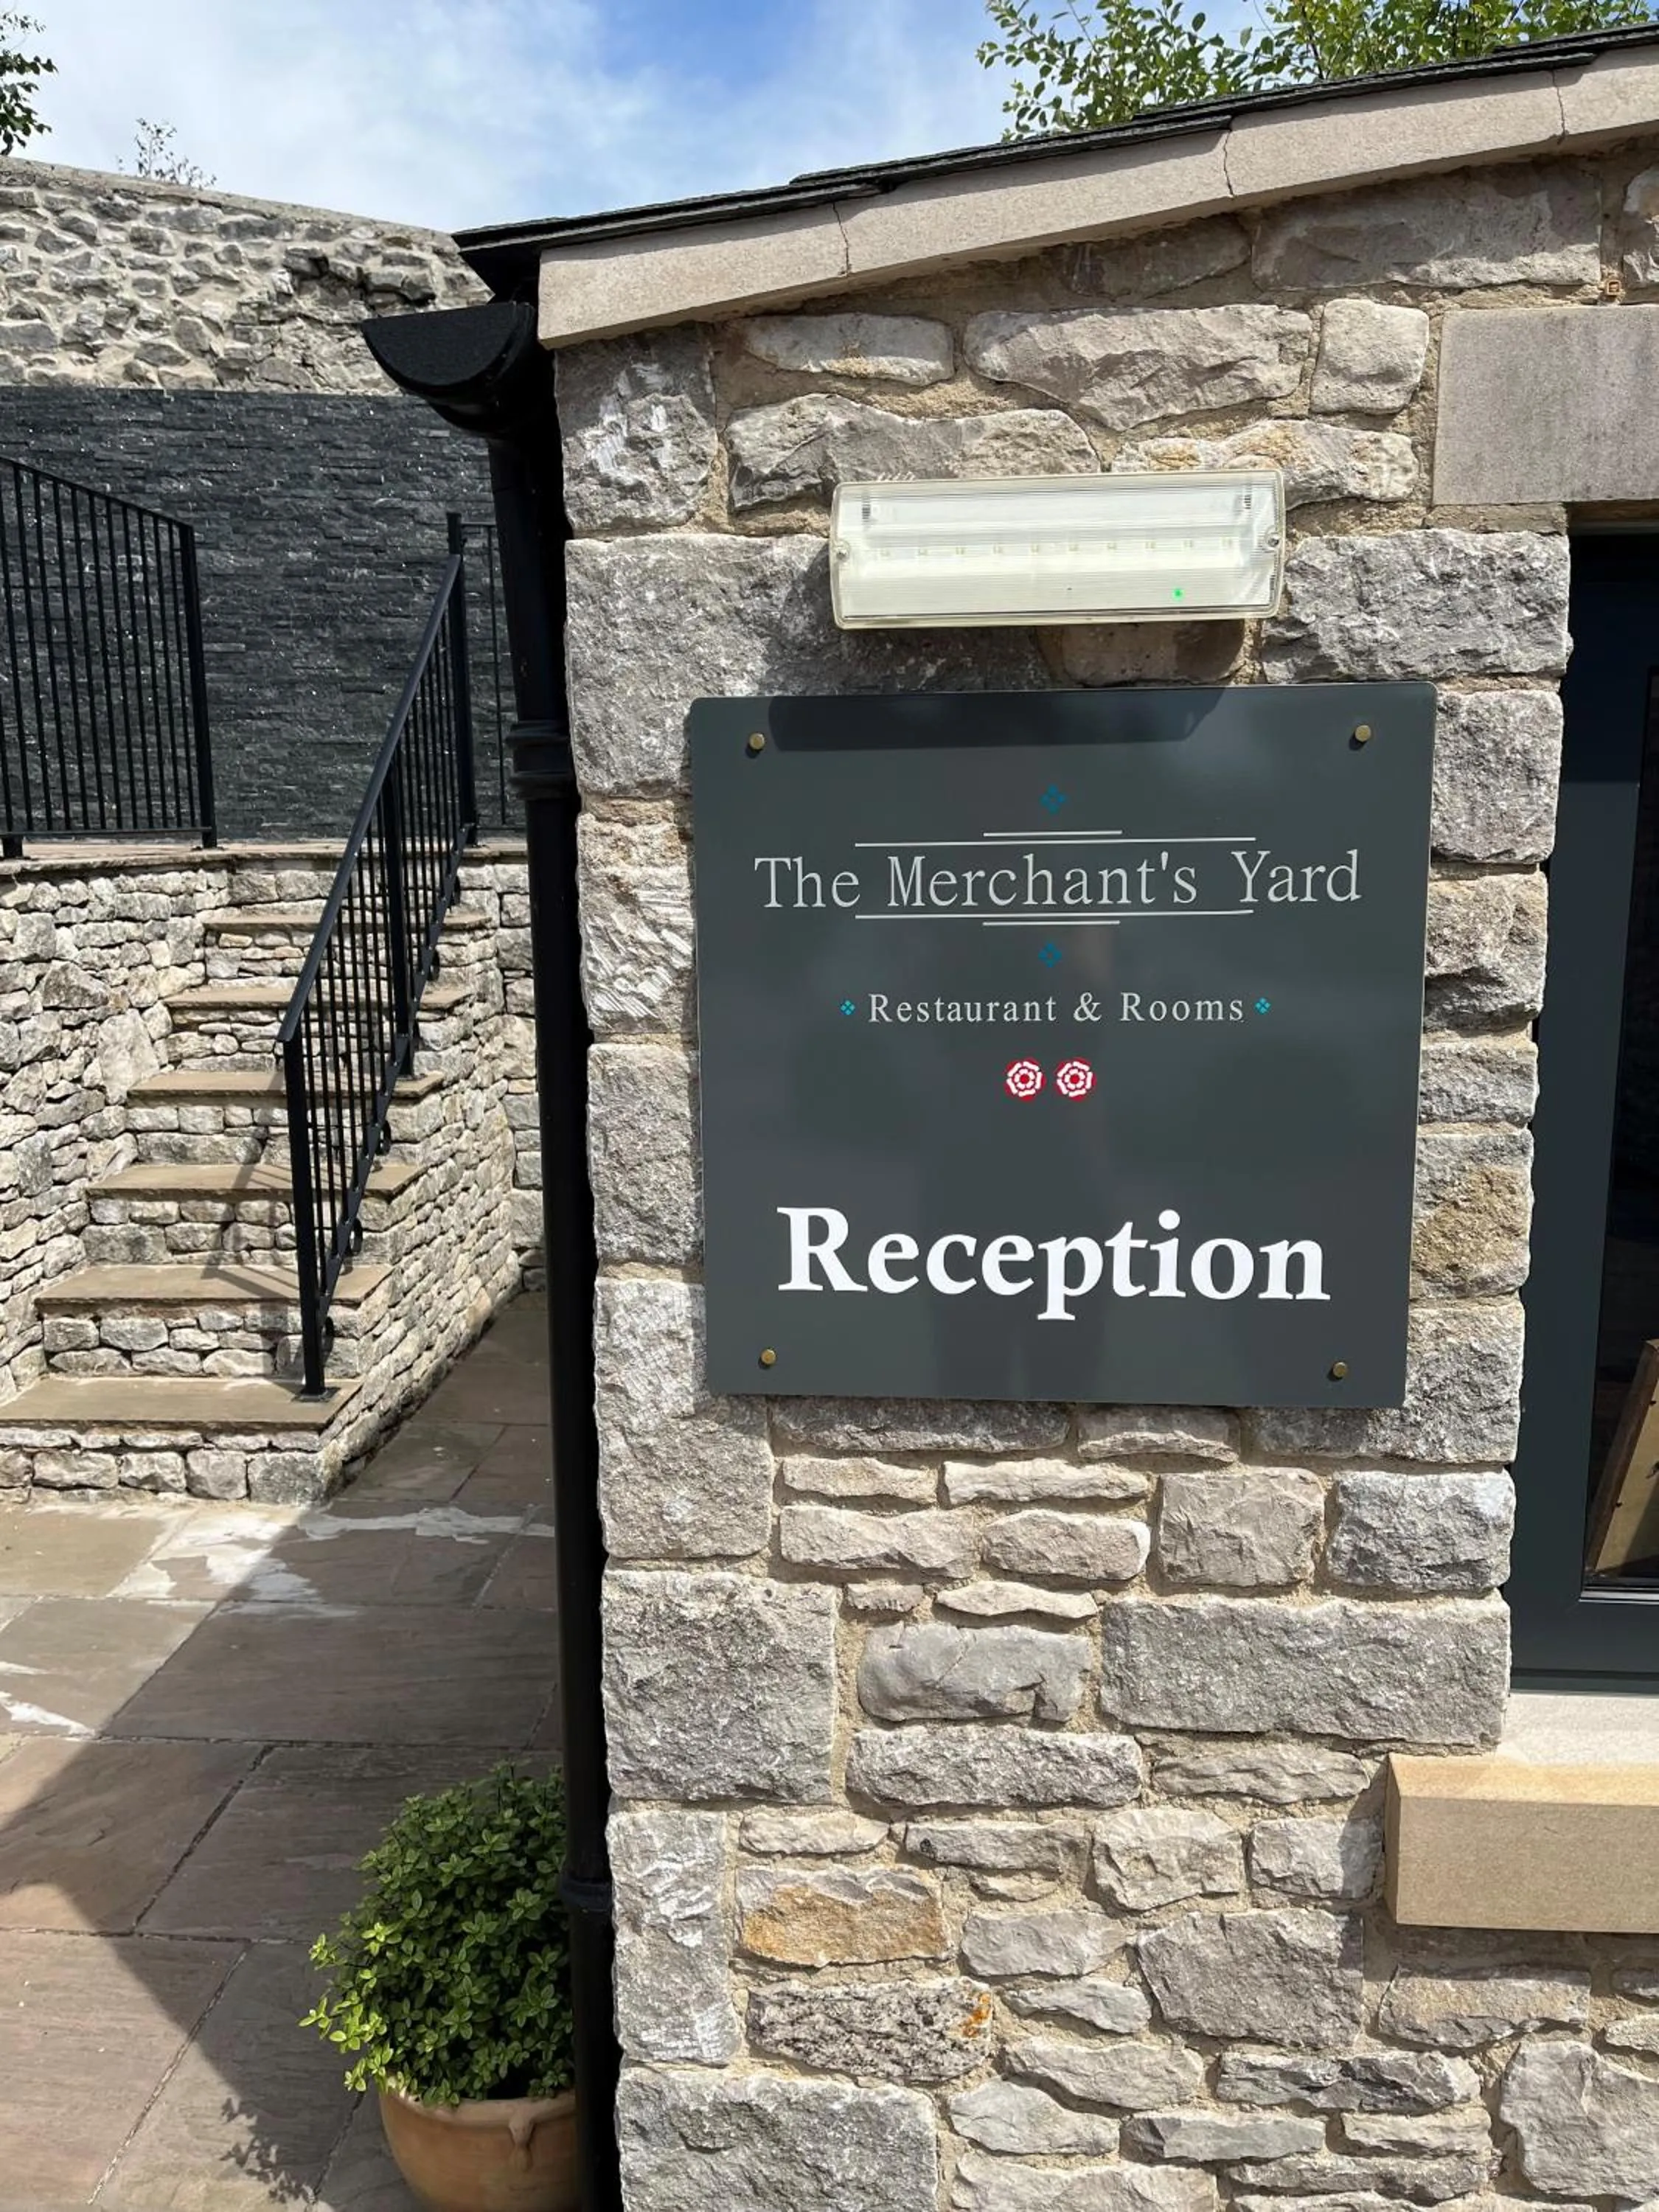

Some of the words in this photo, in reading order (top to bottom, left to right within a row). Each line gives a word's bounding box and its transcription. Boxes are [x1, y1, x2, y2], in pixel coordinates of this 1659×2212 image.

[754, 856, 861, 908] The
[886, 851, 1198, 908] Merchant's
[1230, 849, 1363, 903] Yard
[868, 992, 1057, 1023] Restaurant
[1072, 992, 1102, 1023] &
[1119, 992, 1244, 1022] Rooms
[776, 1206, 1332, 1322] Reception
